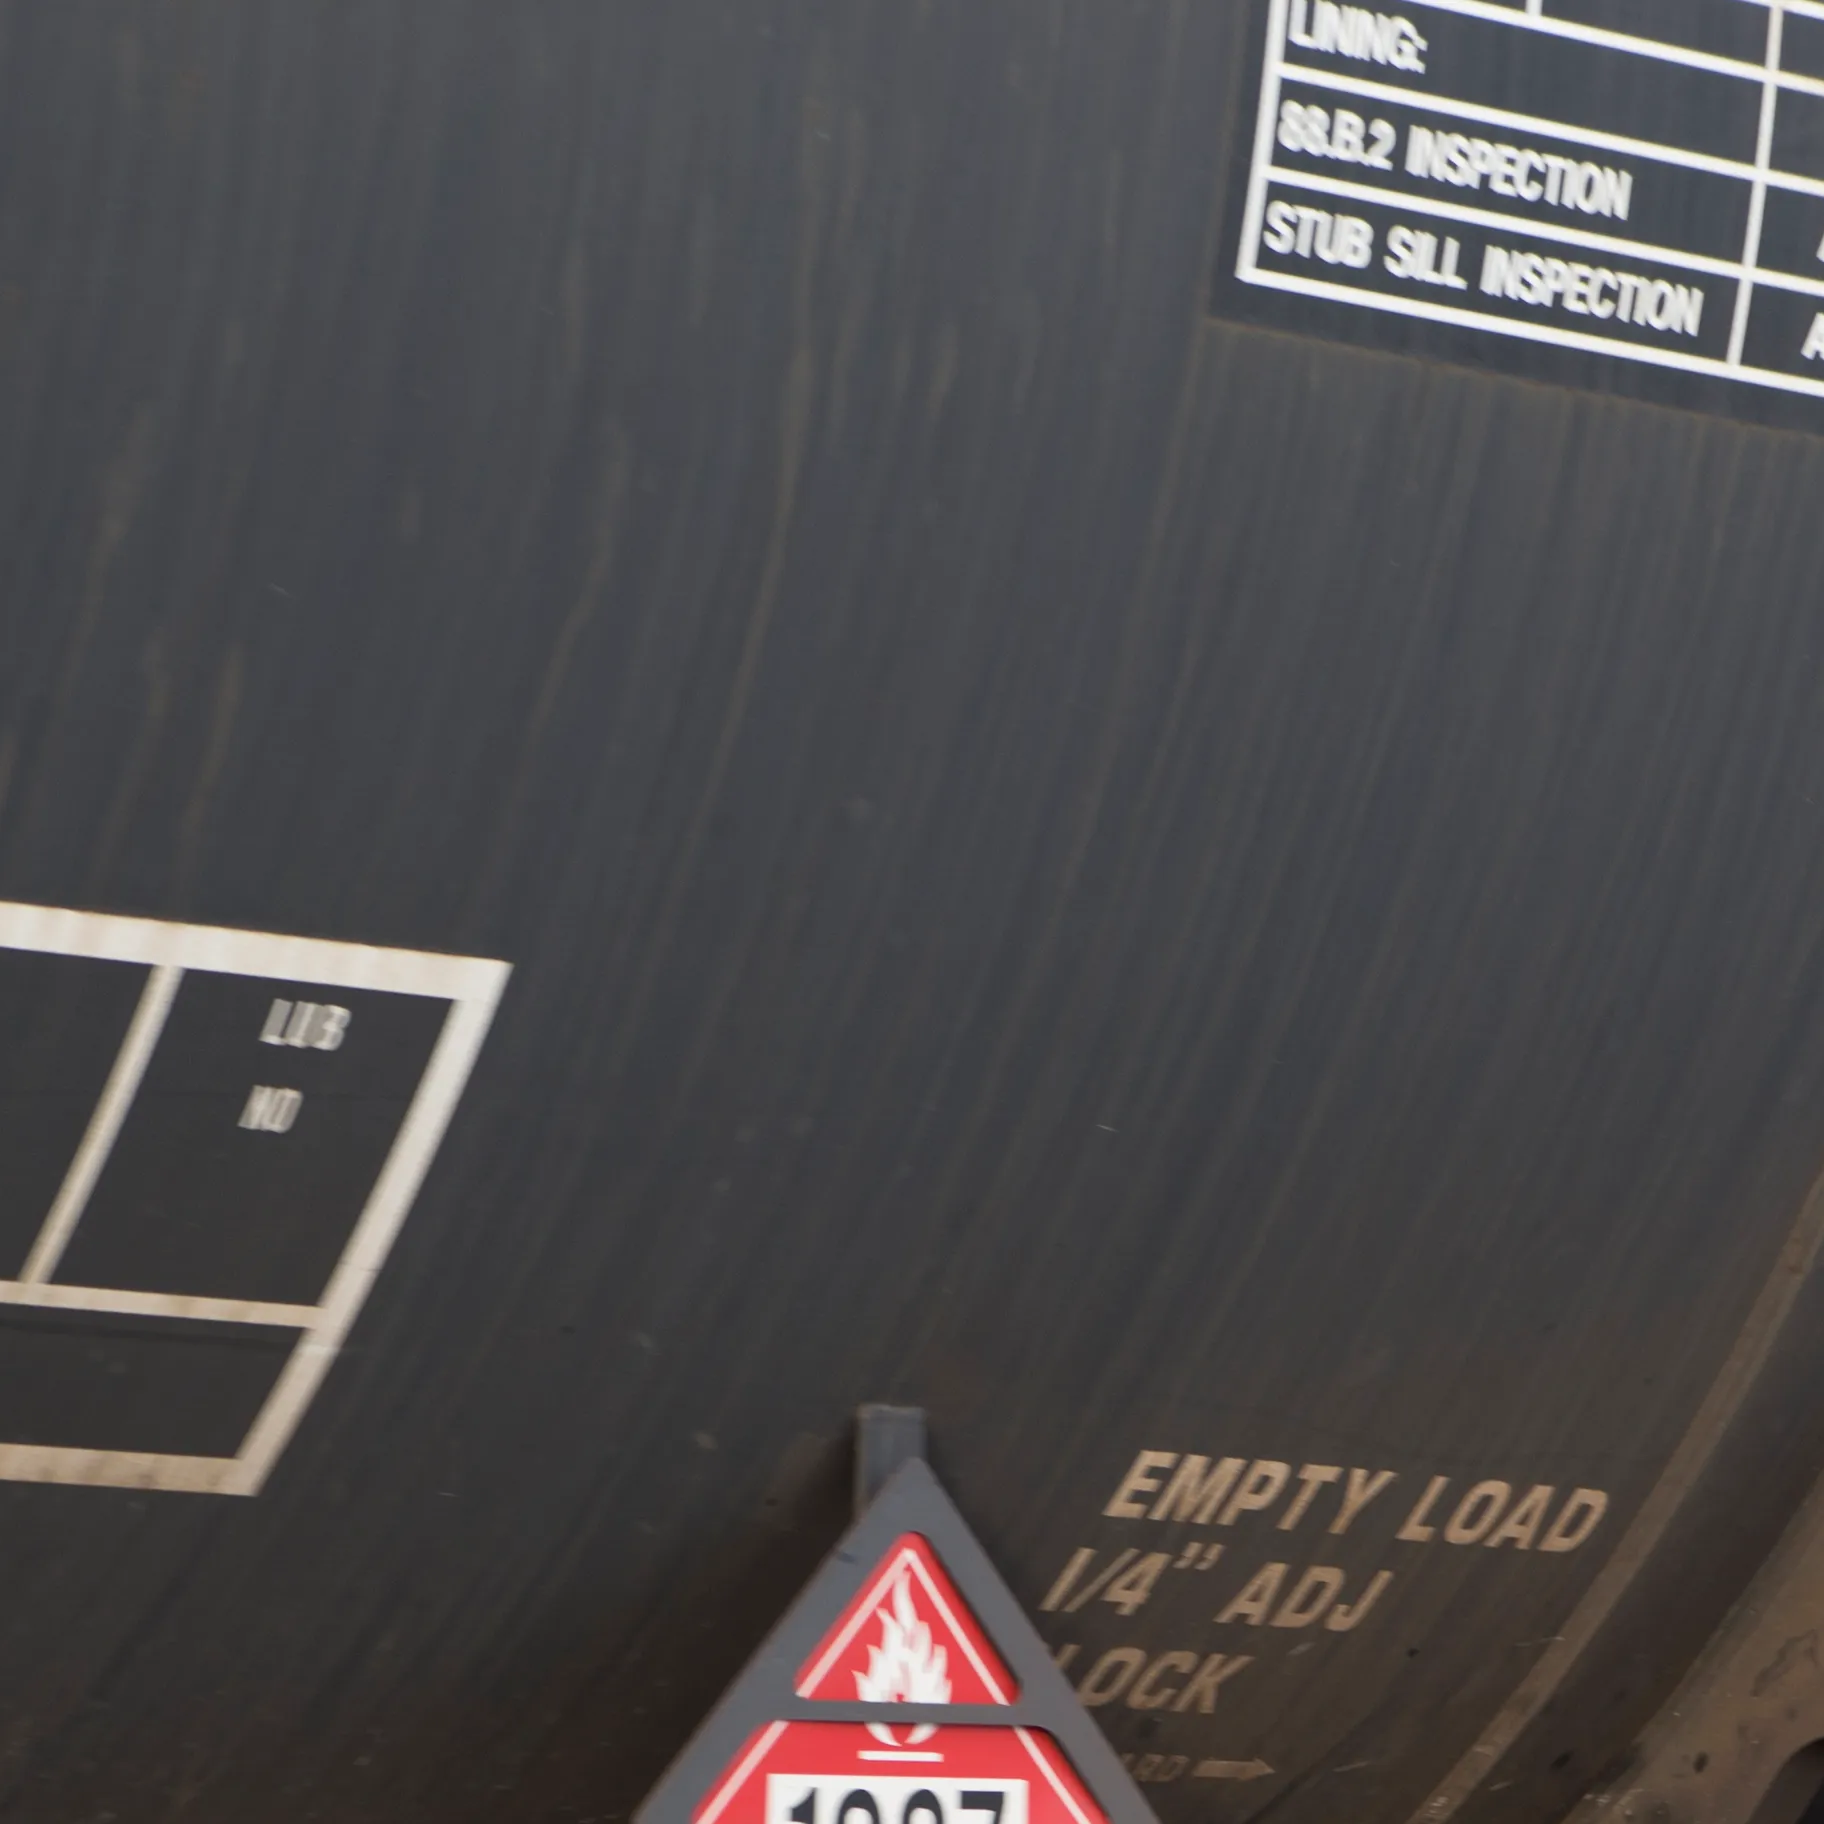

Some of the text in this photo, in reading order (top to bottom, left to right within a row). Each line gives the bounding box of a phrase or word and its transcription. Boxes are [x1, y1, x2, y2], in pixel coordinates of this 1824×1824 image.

[1405, 124, 1633, 221] INSPECTION
[1263, 200, 1704, 337] STUB SILL INSPECTION
[259, 998, 352, 1051] LUB
[1101, 1448, 1609, 1553] EMPTY LOAD
[1212, 1562, 1396, 1632] ADJ
